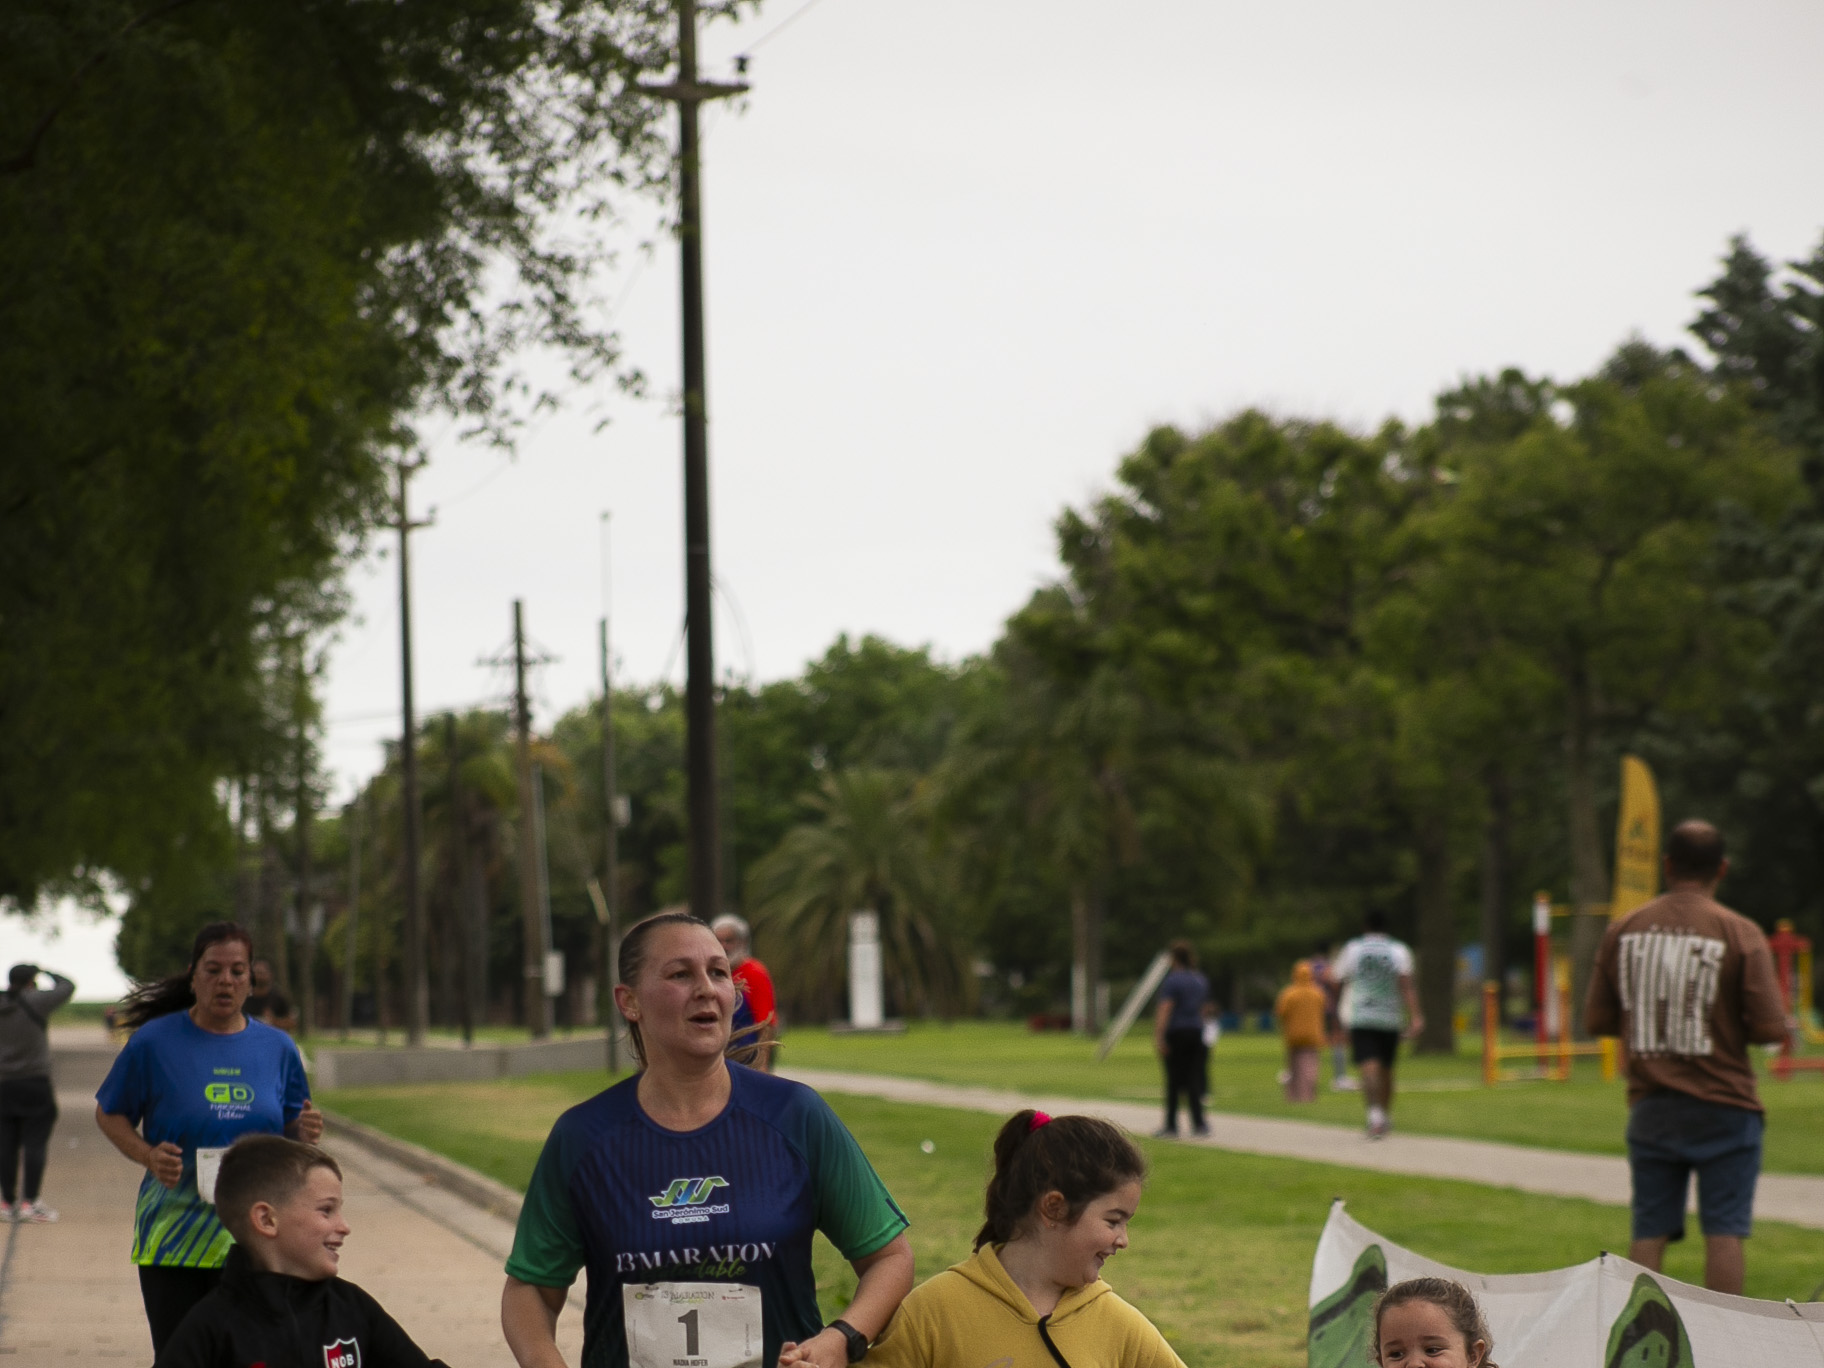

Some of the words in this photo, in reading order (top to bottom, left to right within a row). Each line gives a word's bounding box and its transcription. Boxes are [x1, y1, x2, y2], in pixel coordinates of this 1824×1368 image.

[653, 1209, 669, 1219] San
[711, 1204, 729, 1213] Sud
[672, 1216, 709, 1224] COMUNA
[677, 1309, 699, 1356] 1
[673, 1359, 689, 1367] NADIA
